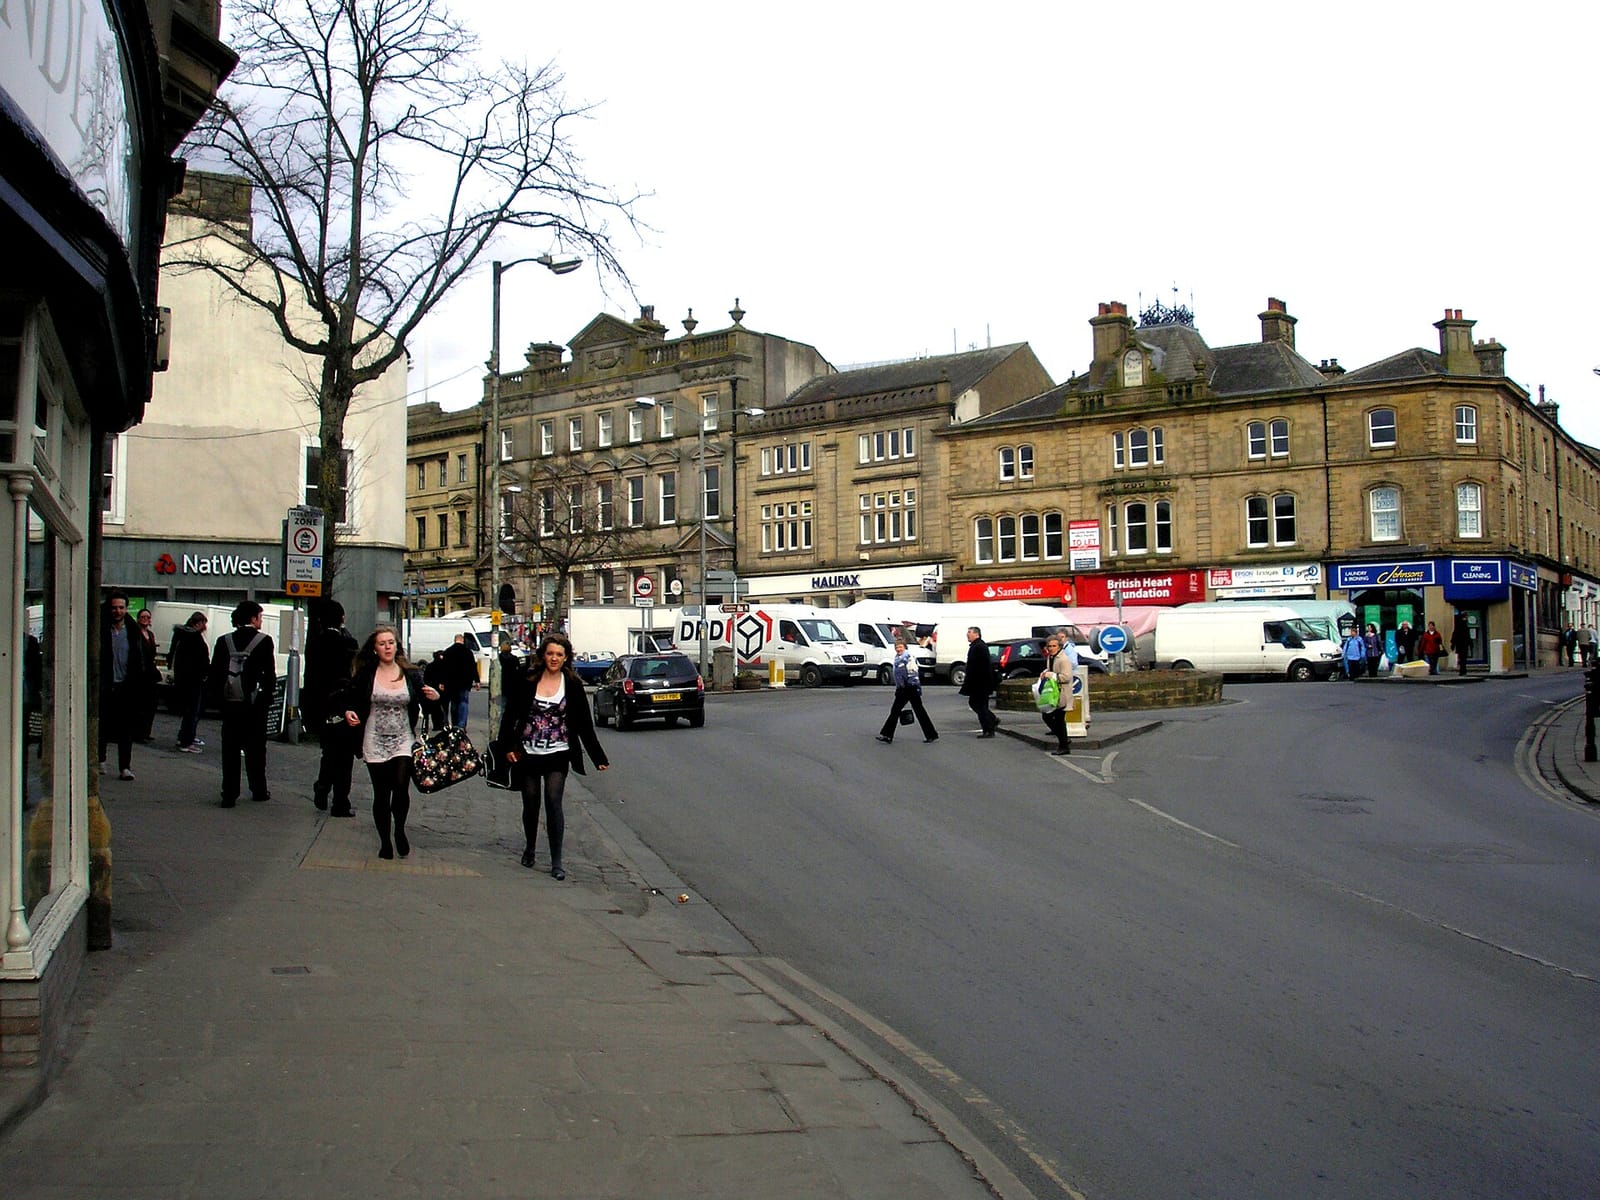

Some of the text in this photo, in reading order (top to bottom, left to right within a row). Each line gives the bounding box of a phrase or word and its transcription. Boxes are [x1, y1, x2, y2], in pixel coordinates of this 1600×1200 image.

[294, 518, 318, 526] ZONE
[1072, 538, 1097, 547] TO LET
[182, 553, 270, 576] NatWest
[811, 574, 860, 589] HALIFAX
[1376, 565, 1424, 585] Johnsons
[1107, 576, 1172, 590] British Heart
[996, 585, 1043, 597] Santander
[1110, 588, 1170, 600] Fundation
